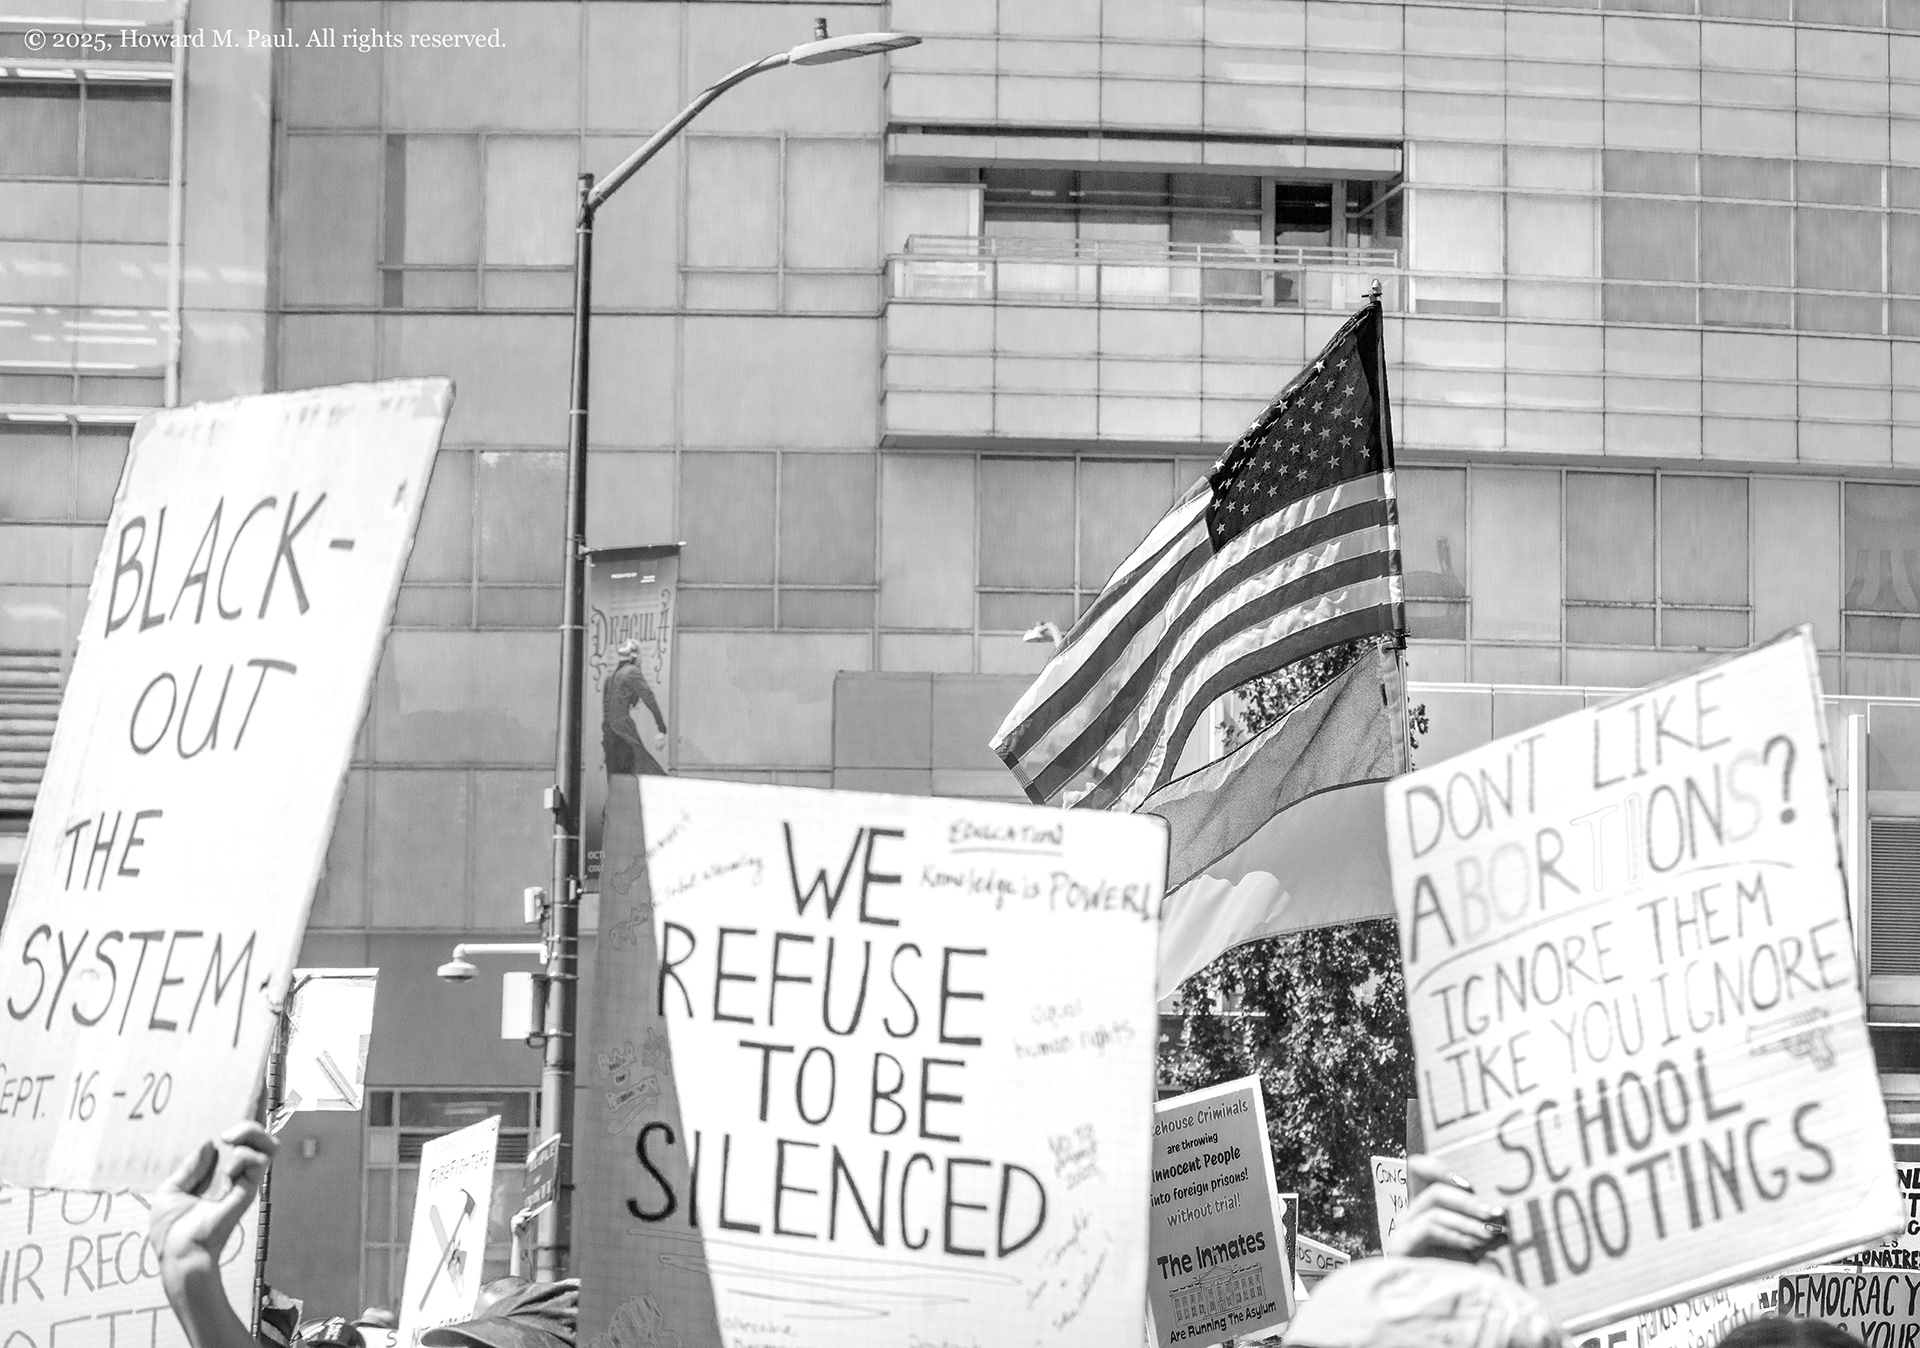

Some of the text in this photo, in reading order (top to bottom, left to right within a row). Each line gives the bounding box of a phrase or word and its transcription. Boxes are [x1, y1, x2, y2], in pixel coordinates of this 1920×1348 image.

[130, 658, 297, 759] OUT
[1593, 676, 1731, 792] LIKE
[65, 809, 163, 891] THE
[783, 820, 905, 927] WE
[1410, 734, 1797, 965] ABORTIONS?
[7, 924, 256, 1049] SYSTEM
[658, 921, 988, 1047] REFUSE
[1430, 870, 1774, 1042] IGNORE THEM
[1425, 918, 1852, 1131] LIKE YOU IGNORE
[739, 1039, 837, 1128] TO
[868, 1052, 967, 1144] BE
[1152, 1100, 1249, 1140] ehouse Criminals
[1496, 1047, 1744, 1197] SCHOOL
[626, 1122, 1048, 1258] SILENCED
[1150, 1167, 1249, 1207] into foreign prisons!
[1151, 1145, 1241, 1183] Innocent People
[1166, 1132, 1219, 1155] are throwing
[1167, 1193, 1242, 1228] without trial!
[1389, 1193, 1408, 1214] YO
[1488, 1102, 1836, 1288] HOOTINGS
[1157, 1230, 1266, 1280] The Inmates
[1297, 1248, 1317, 1264] DS
[1779, 1273, 1920, 1318] DEMOCRACY
[1170, 1300, 1277, 1344] Are Running The Asylum
